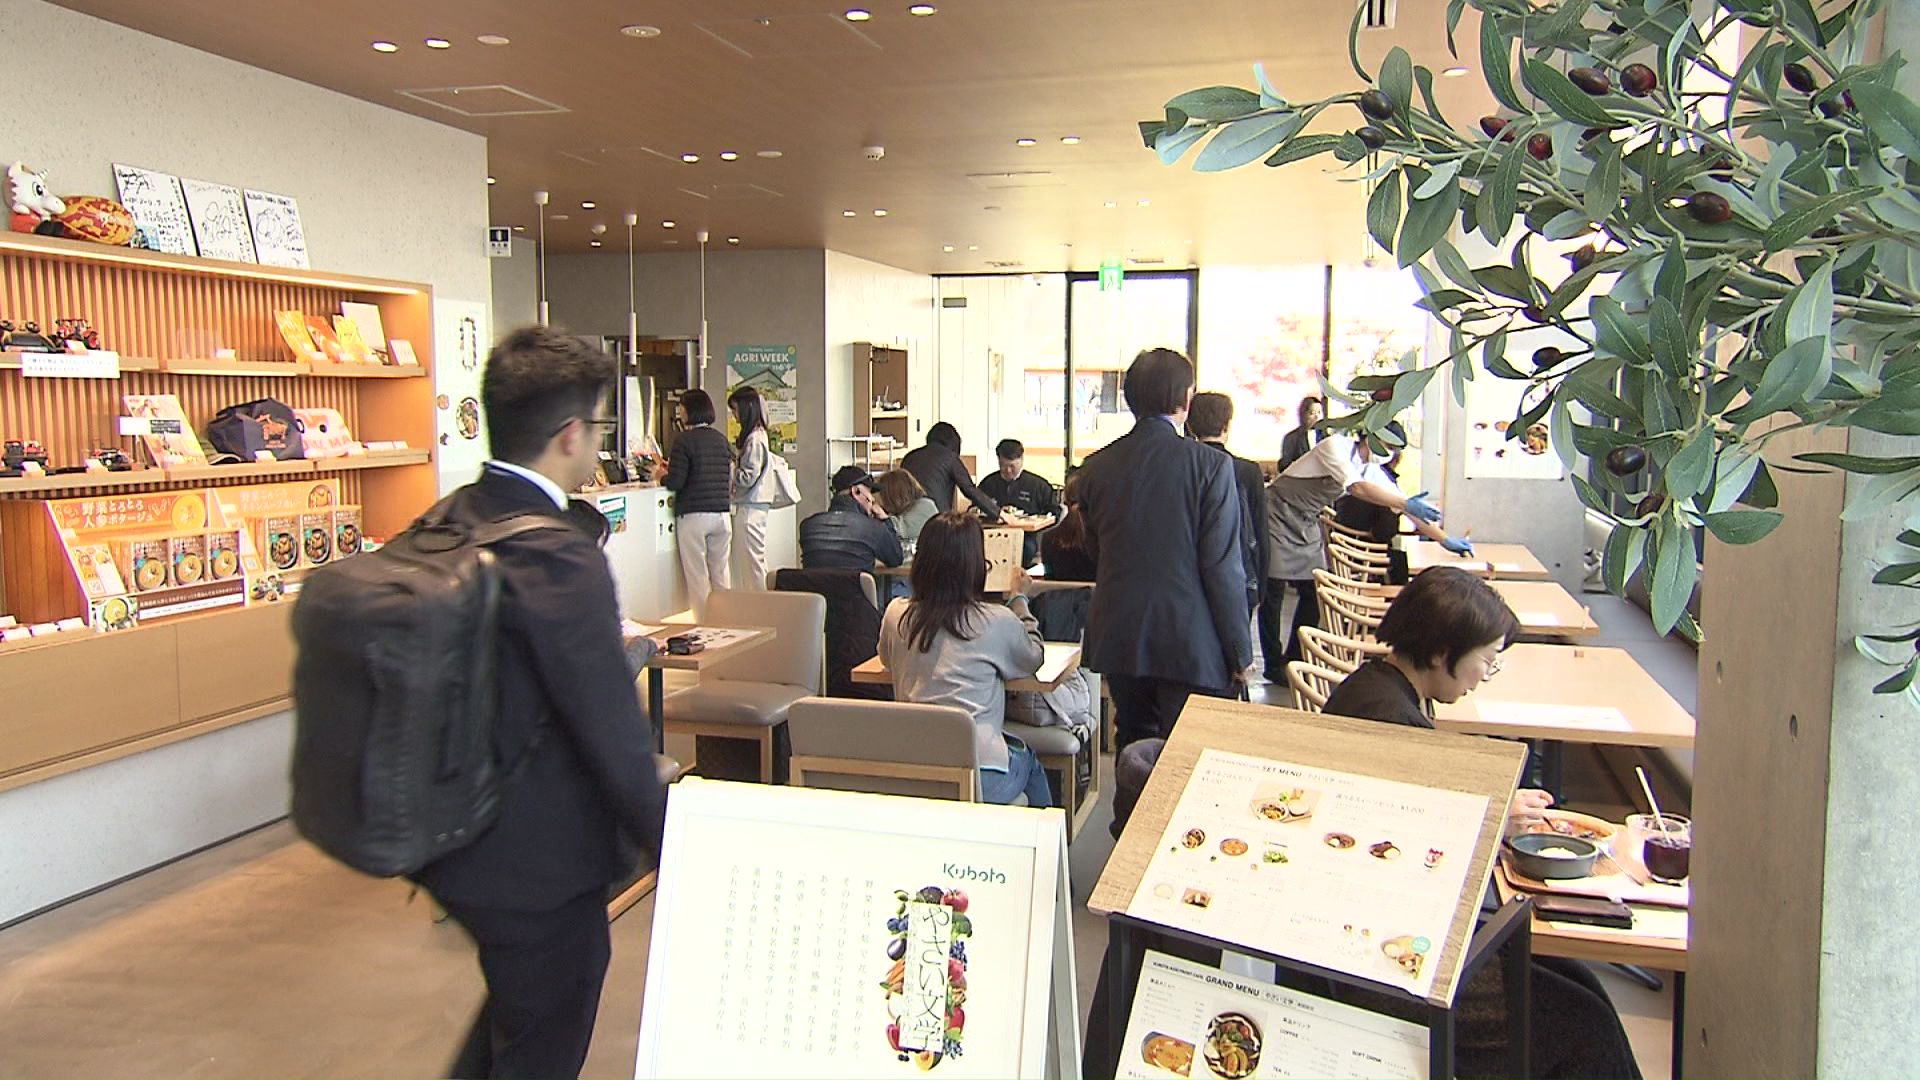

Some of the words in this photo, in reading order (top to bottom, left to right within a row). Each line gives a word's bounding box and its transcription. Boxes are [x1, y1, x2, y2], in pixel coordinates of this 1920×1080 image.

[734, 353, 758, 362] AGRI
[760, 353, 789, 362] WEEK
[82, 498, 144, 516] 野菜とろとろ
[84, 511, 154, 528] 人参ポタージュ
[1262, 765, 1276, 773] SET
[1279, 768, 1303, 777] MENU
[943, 863, 1006, 884] Kubota
[913, 906, 950, 1050] やさい文学
[1205, 975, 1234, 989] GRAND
[1235, 983, 1260, 997] MENU
